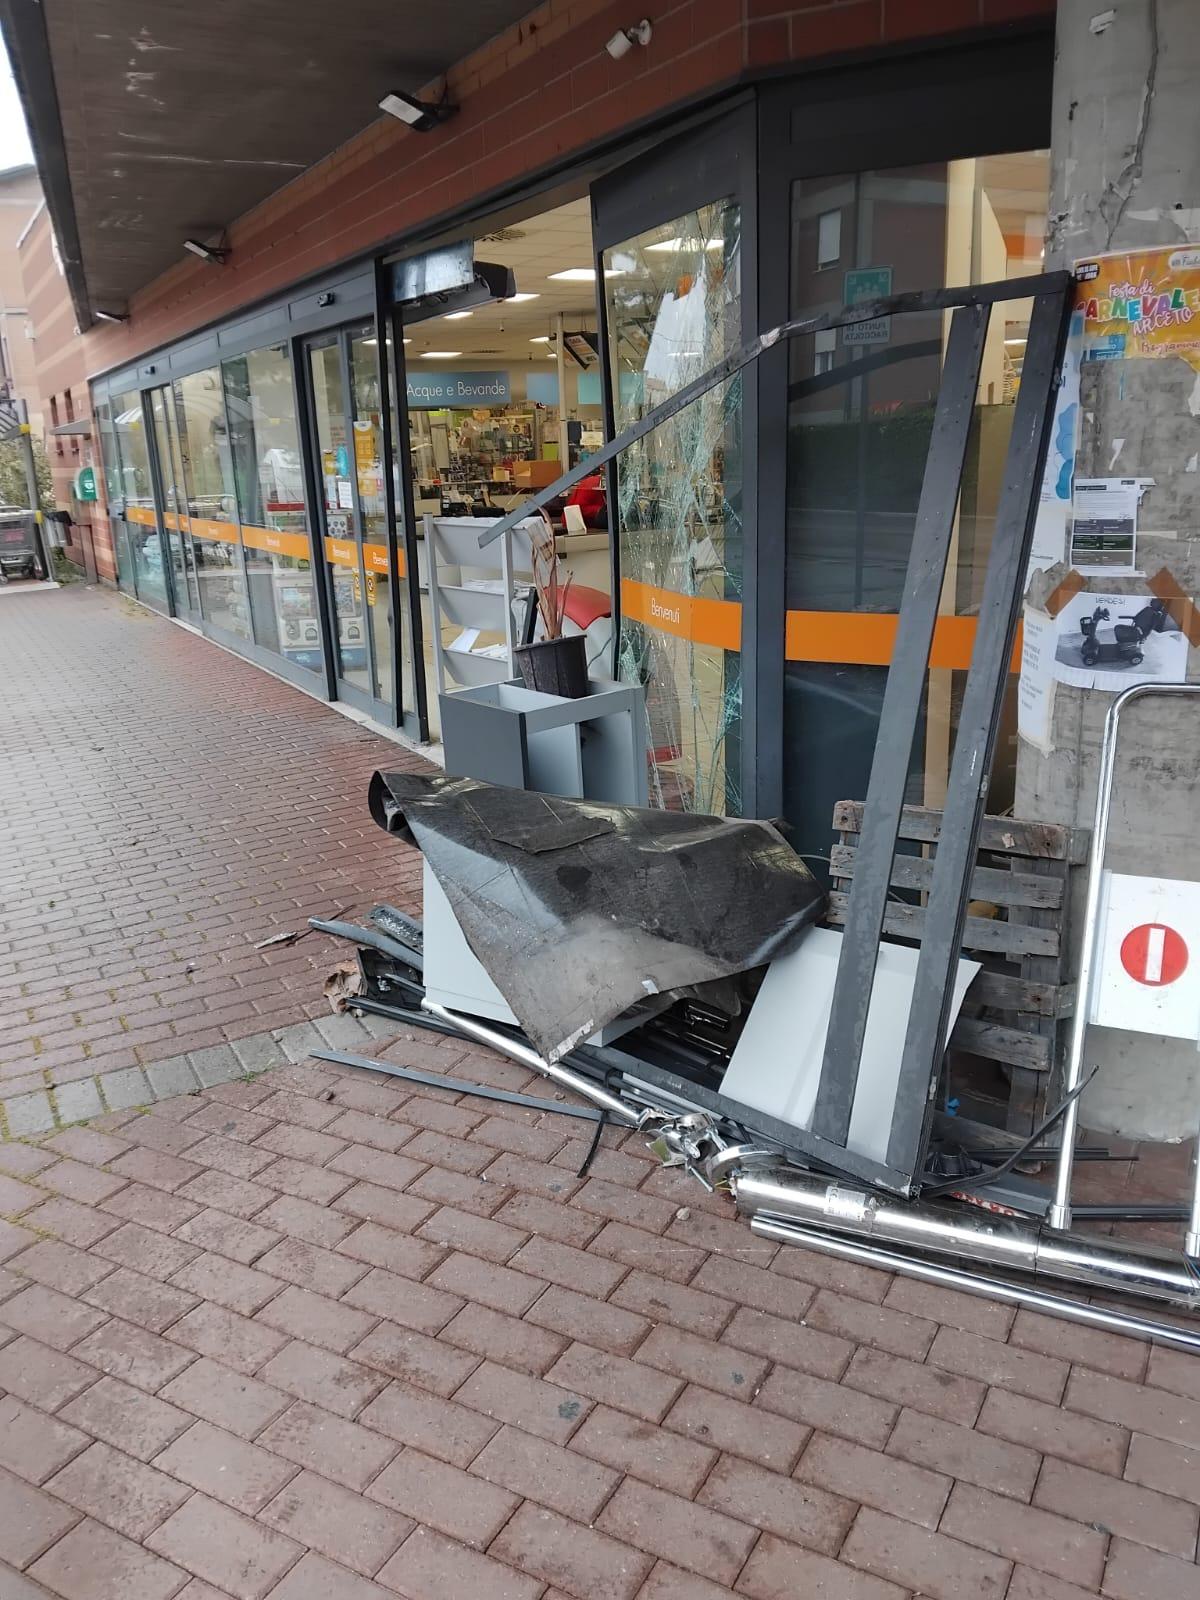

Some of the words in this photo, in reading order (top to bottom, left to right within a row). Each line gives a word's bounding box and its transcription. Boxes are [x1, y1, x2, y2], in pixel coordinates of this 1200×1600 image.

[1108, 283, 1137, 298] Festa
[1139, 279, 1155, 294] di
[407, 383, 443, 401] Acque
[446, 387, 454, 397] e
[457, 380, 506, 397] Bevande
[651, 597, 681, 625] Benvenuti
